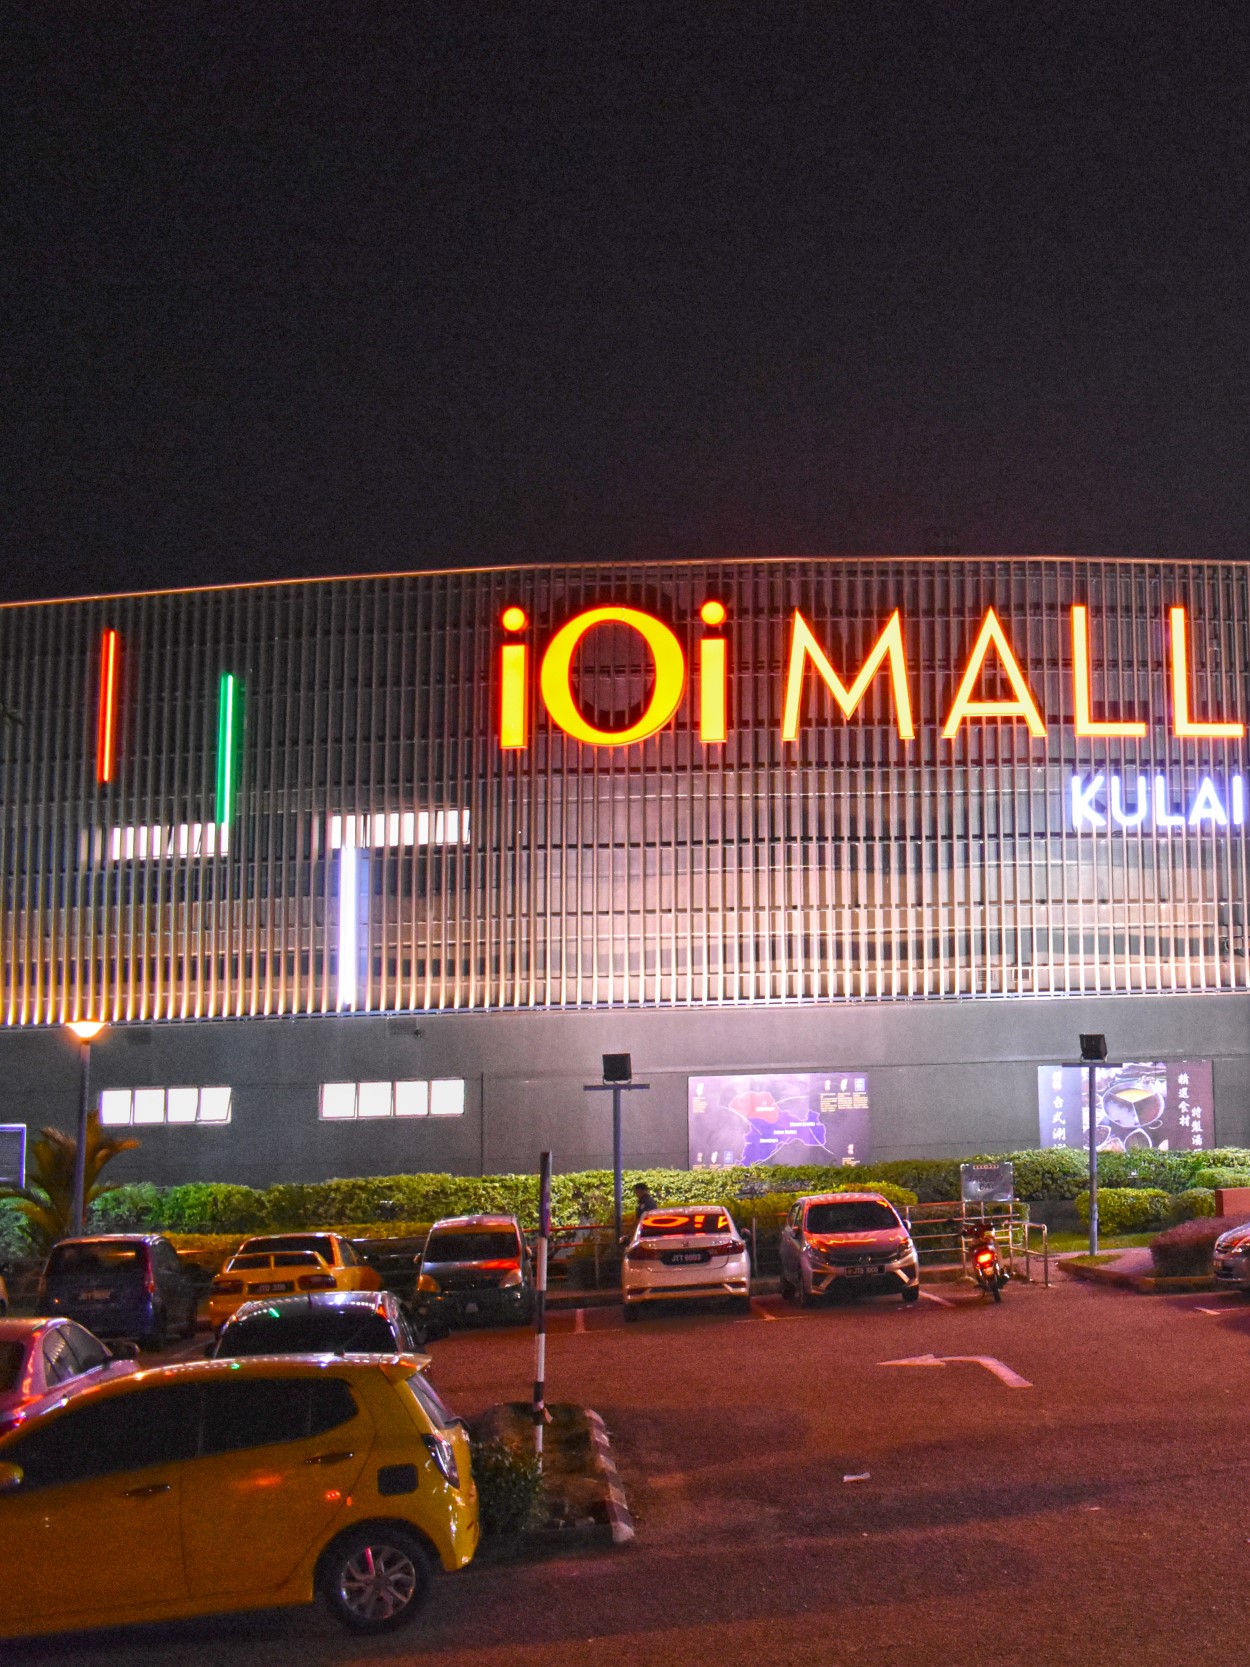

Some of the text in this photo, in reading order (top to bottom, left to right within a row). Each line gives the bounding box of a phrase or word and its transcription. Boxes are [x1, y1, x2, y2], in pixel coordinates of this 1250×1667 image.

[781, 606, 1246, 741] MALL
[1071, 774, 1246, 827] KULAI
[1191, 1106, 1203, 1150] 特製湯
